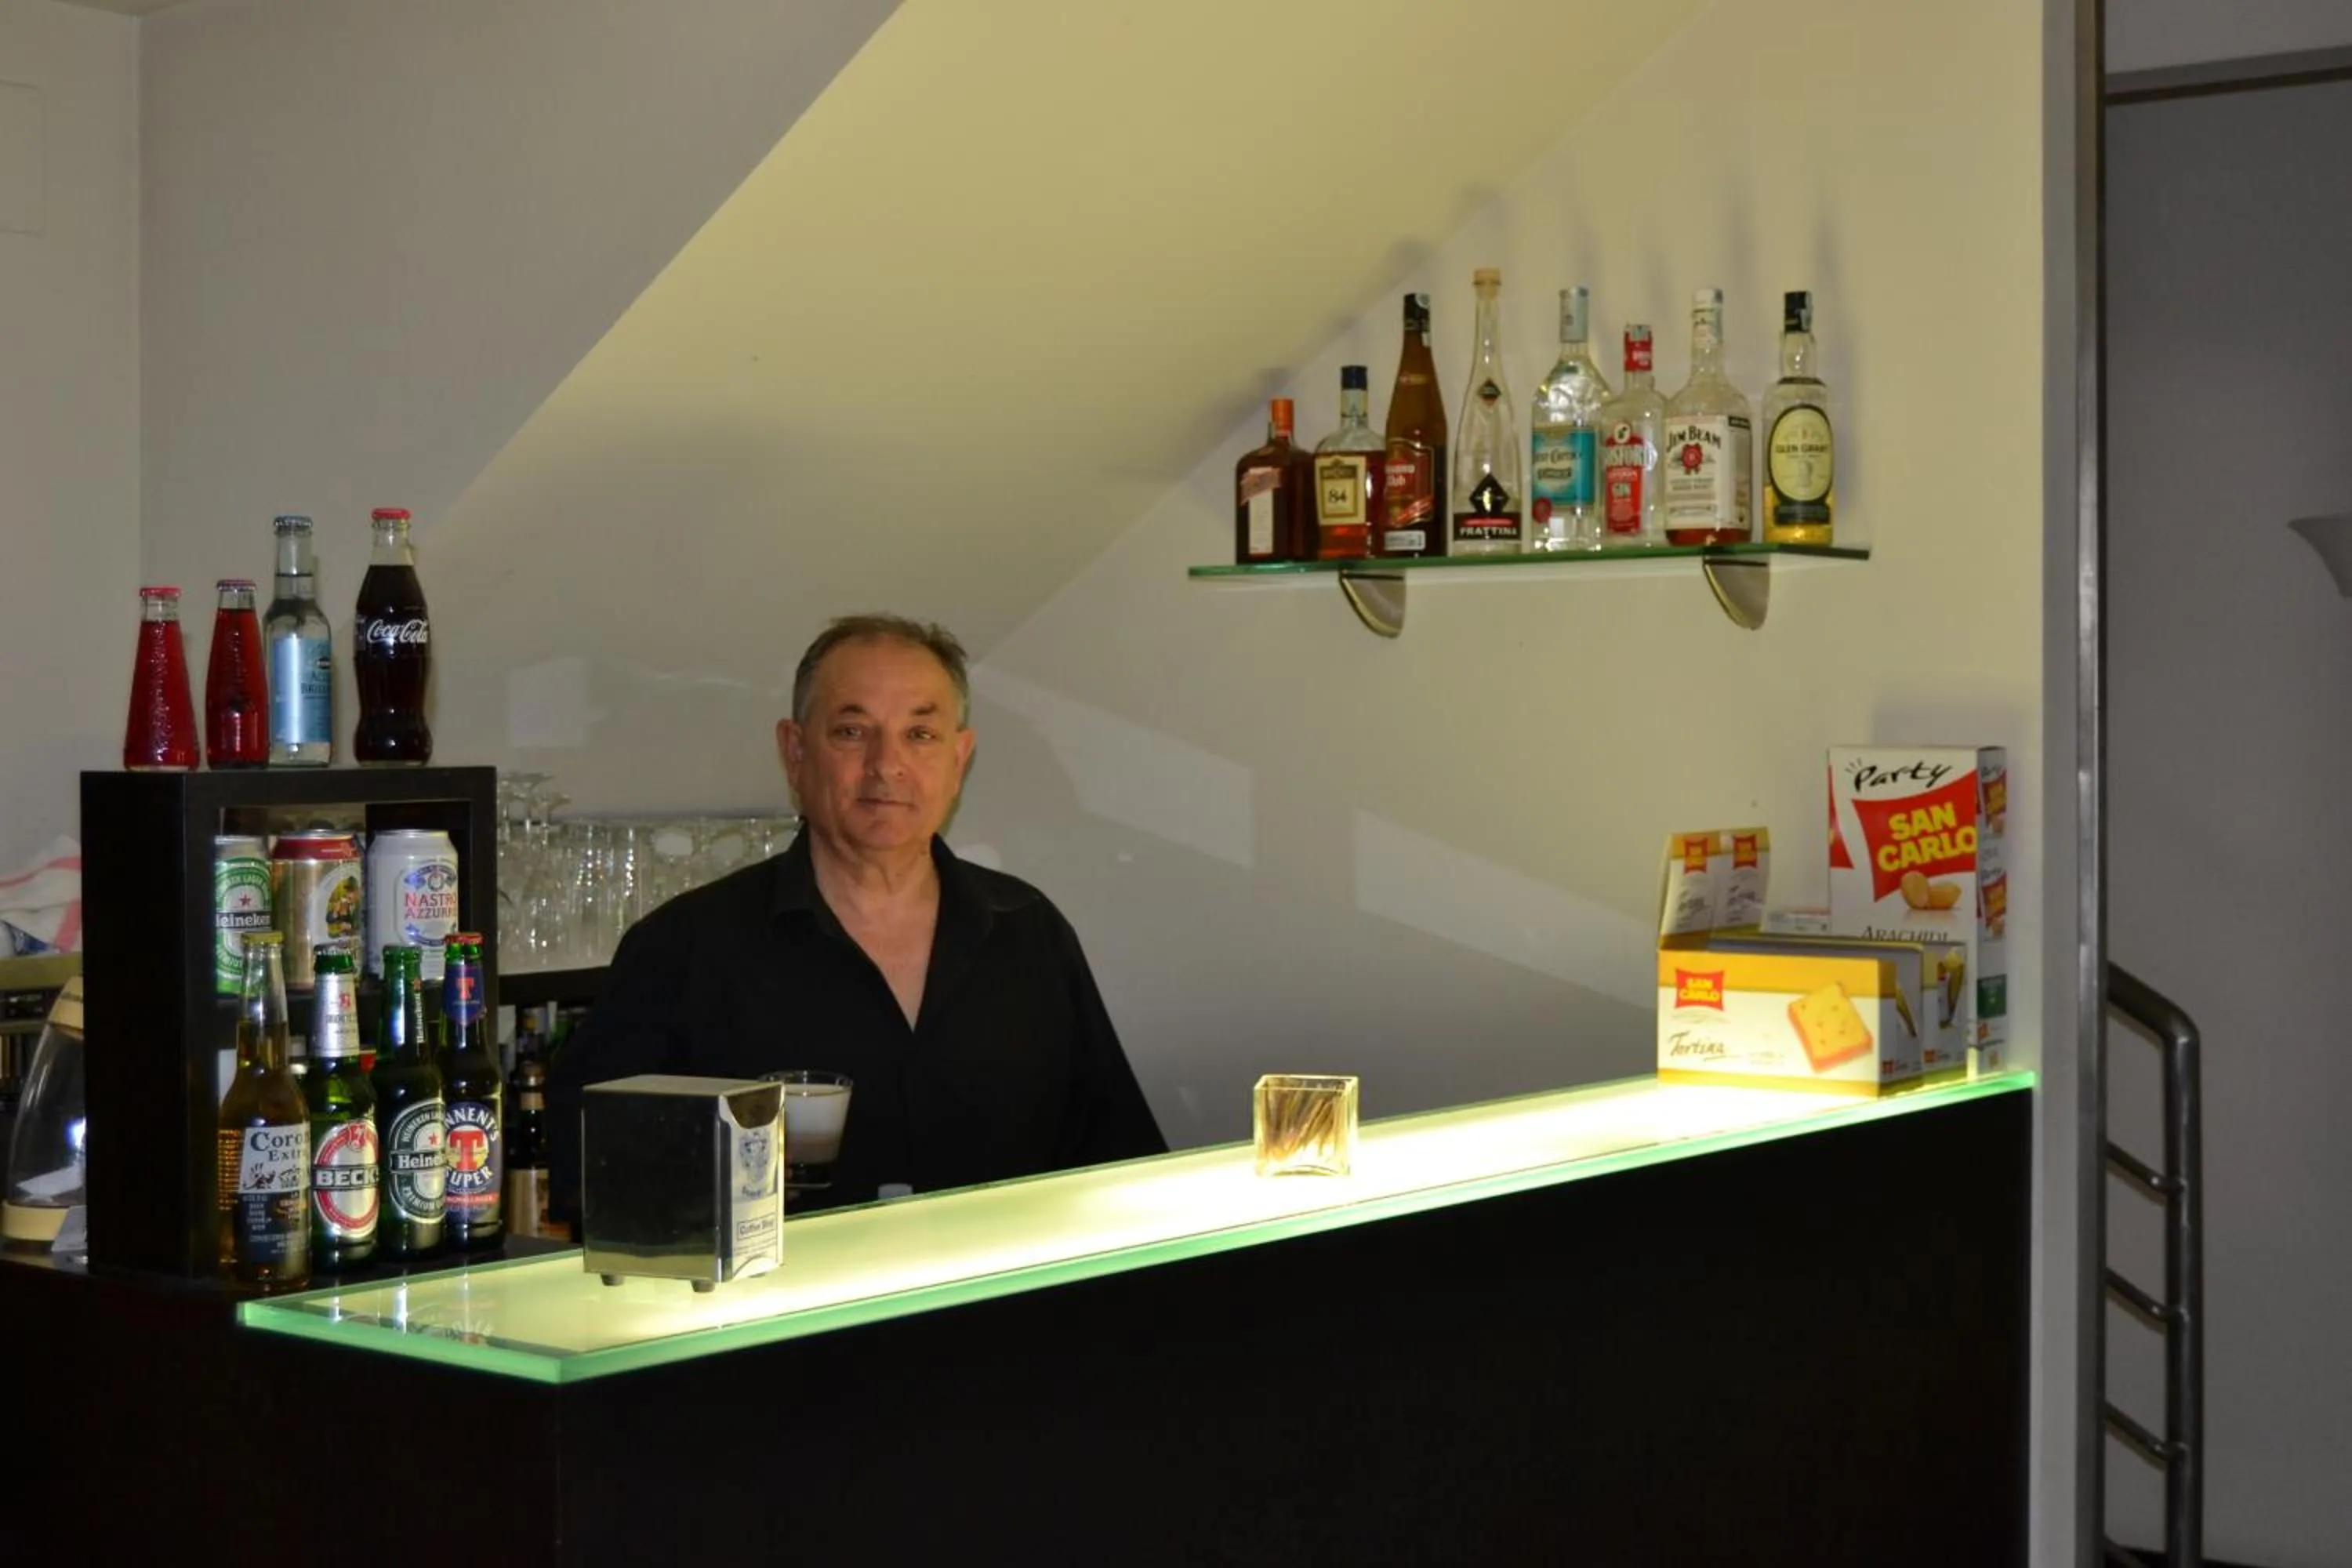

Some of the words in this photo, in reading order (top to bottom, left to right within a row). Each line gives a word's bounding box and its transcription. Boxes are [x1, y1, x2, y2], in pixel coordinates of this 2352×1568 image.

[1666, 430, 1686, 452] JIM
[1688, 426, 1721, 449] BEAM
[1329, 489, 1347, 503] 84
[1459, 526, 1517, 536] FRATTINI
[1854, 760, 1952, 793] Party
[1889, 801, 1957, 841] SAN
[1878, 826, 1977, 872] CARLO
[1686, 978, 1714, 989] SAN
[1679, 989, 1720, 1002] CARLO
[445, 1107, 499, 1142] NNENT'S
[250, 1131, 308, 1152] Coro
[450, 1130, 485, 1171] T
[316, 1168, 379, 1186] BECK
